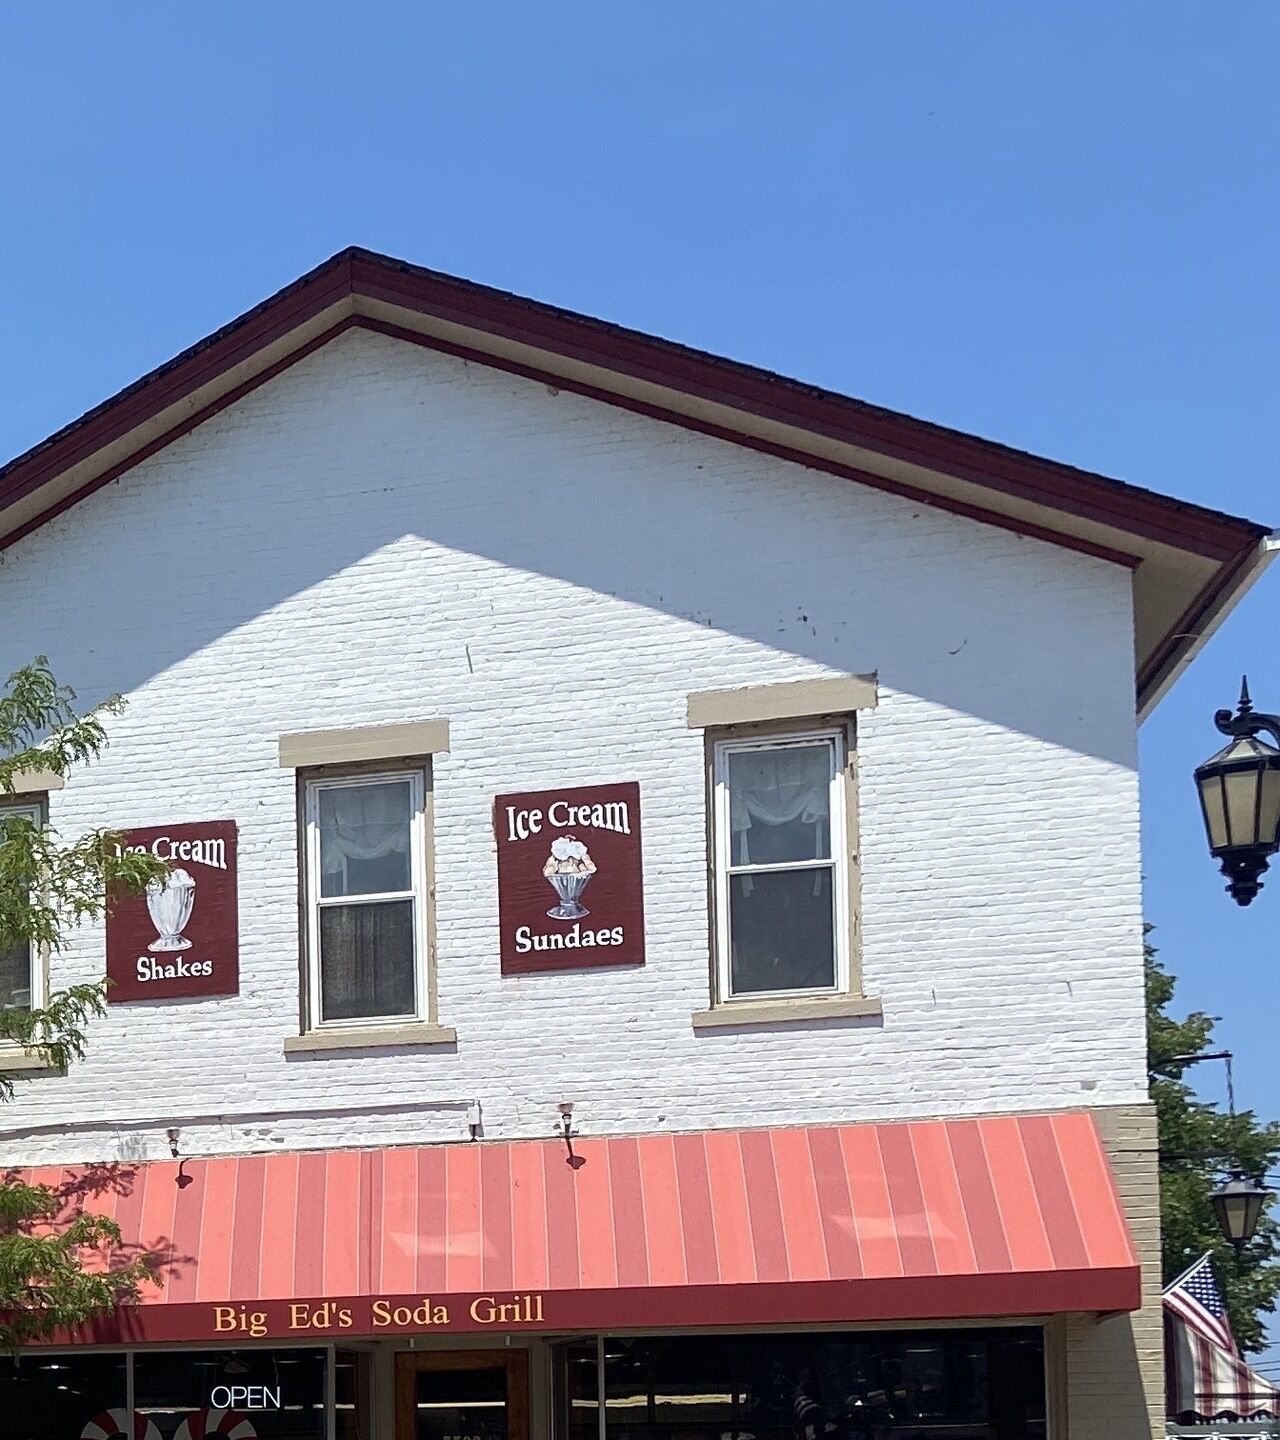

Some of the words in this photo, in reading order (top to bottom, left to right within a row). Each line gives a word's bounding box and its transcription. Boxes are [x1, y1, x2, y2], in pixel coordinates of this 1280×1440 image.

[506, 806, 542, 841] Ice
[548, 801, 631, 835] Cream
[152, 837, 227, 870] Cream
[515, 923, 624, 953] Sundaes
[136, 956, 213, 982] Shakes
[213, 1305, 268, 1337] Big
[288, 1303, 353, 1330] Ed's
[372, 1299, 450, 1327] Soda
[470, 1295, 545, 1324] Grill
[210, 1385, 281, 1410] OPEN
